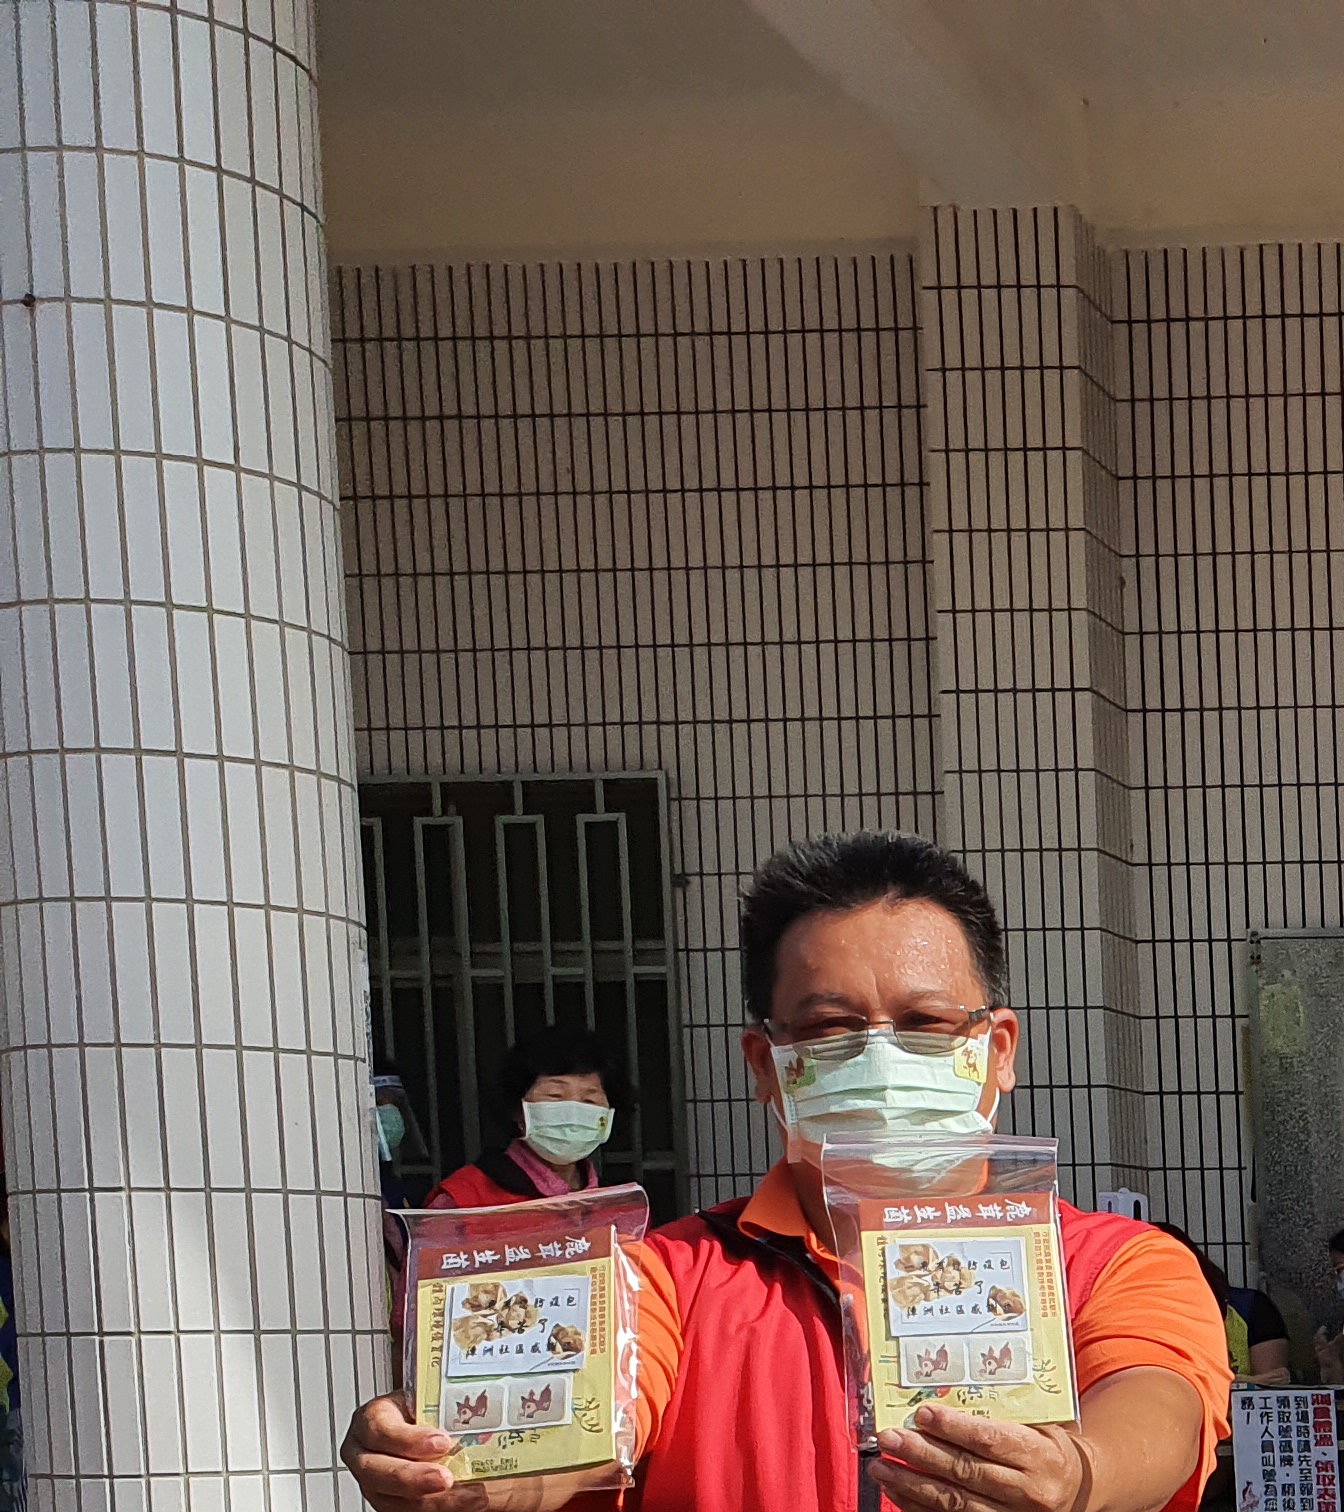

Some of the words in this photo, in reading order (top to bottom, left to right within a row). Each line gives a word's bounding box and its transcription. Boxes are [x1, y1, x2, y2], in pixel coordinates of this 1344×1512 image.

[883, 1198, 1032, 1224] 鹿茸益生菌
[441, 1235, 592, 1269] 鹿茸益生菌
